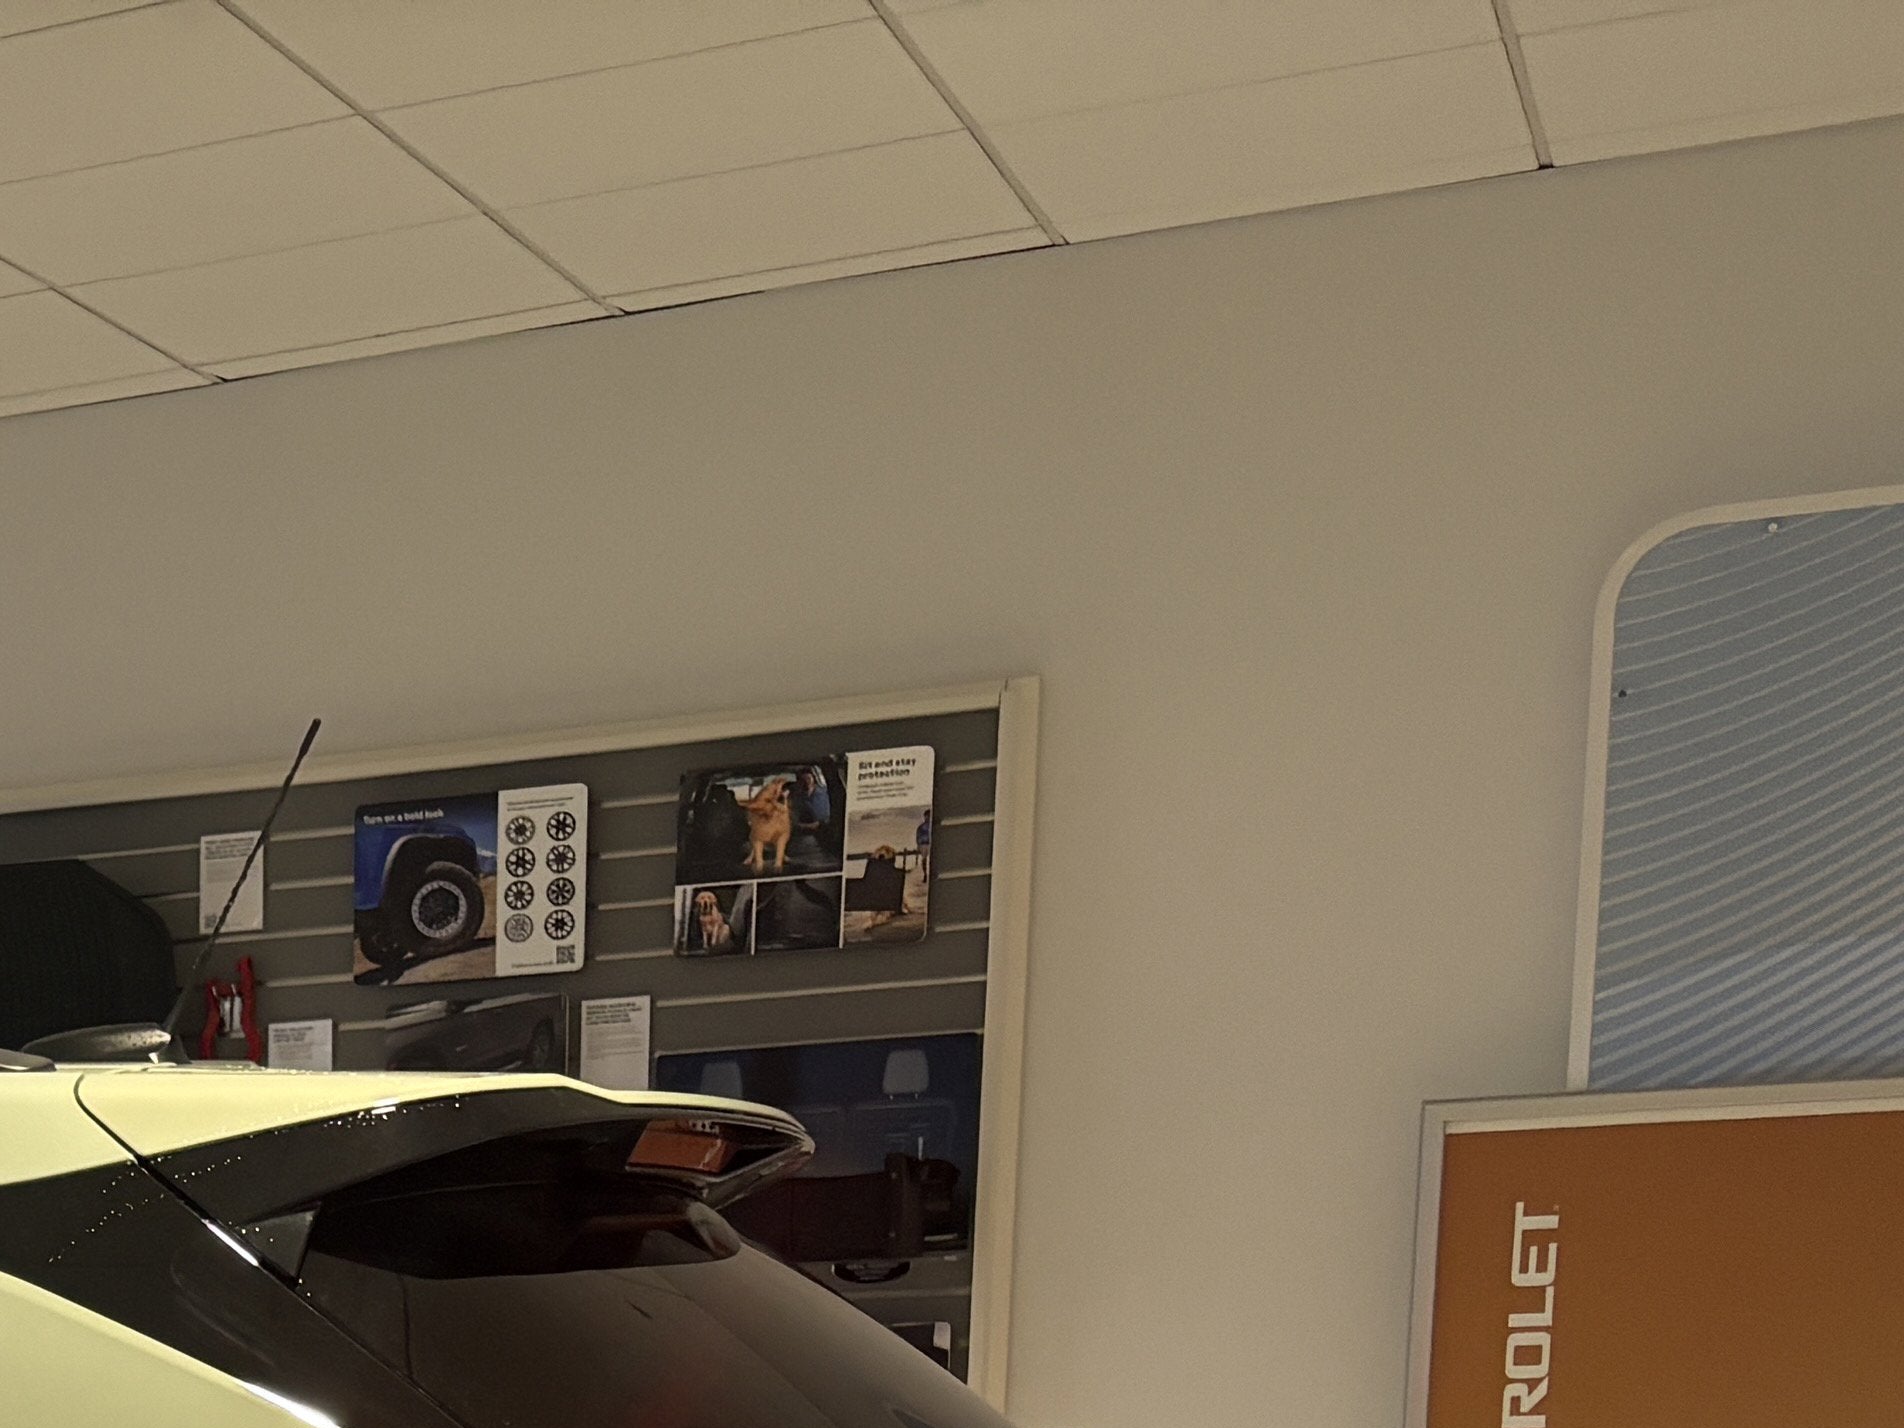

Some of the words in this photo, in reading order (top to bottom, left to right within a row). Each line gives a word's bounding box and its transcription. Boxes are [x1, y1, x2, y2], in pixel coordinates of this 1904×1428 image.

[874, 759, 893, 768] and
[895, 758, 916, 767] stay
[858, 768, 910, 781] protection
